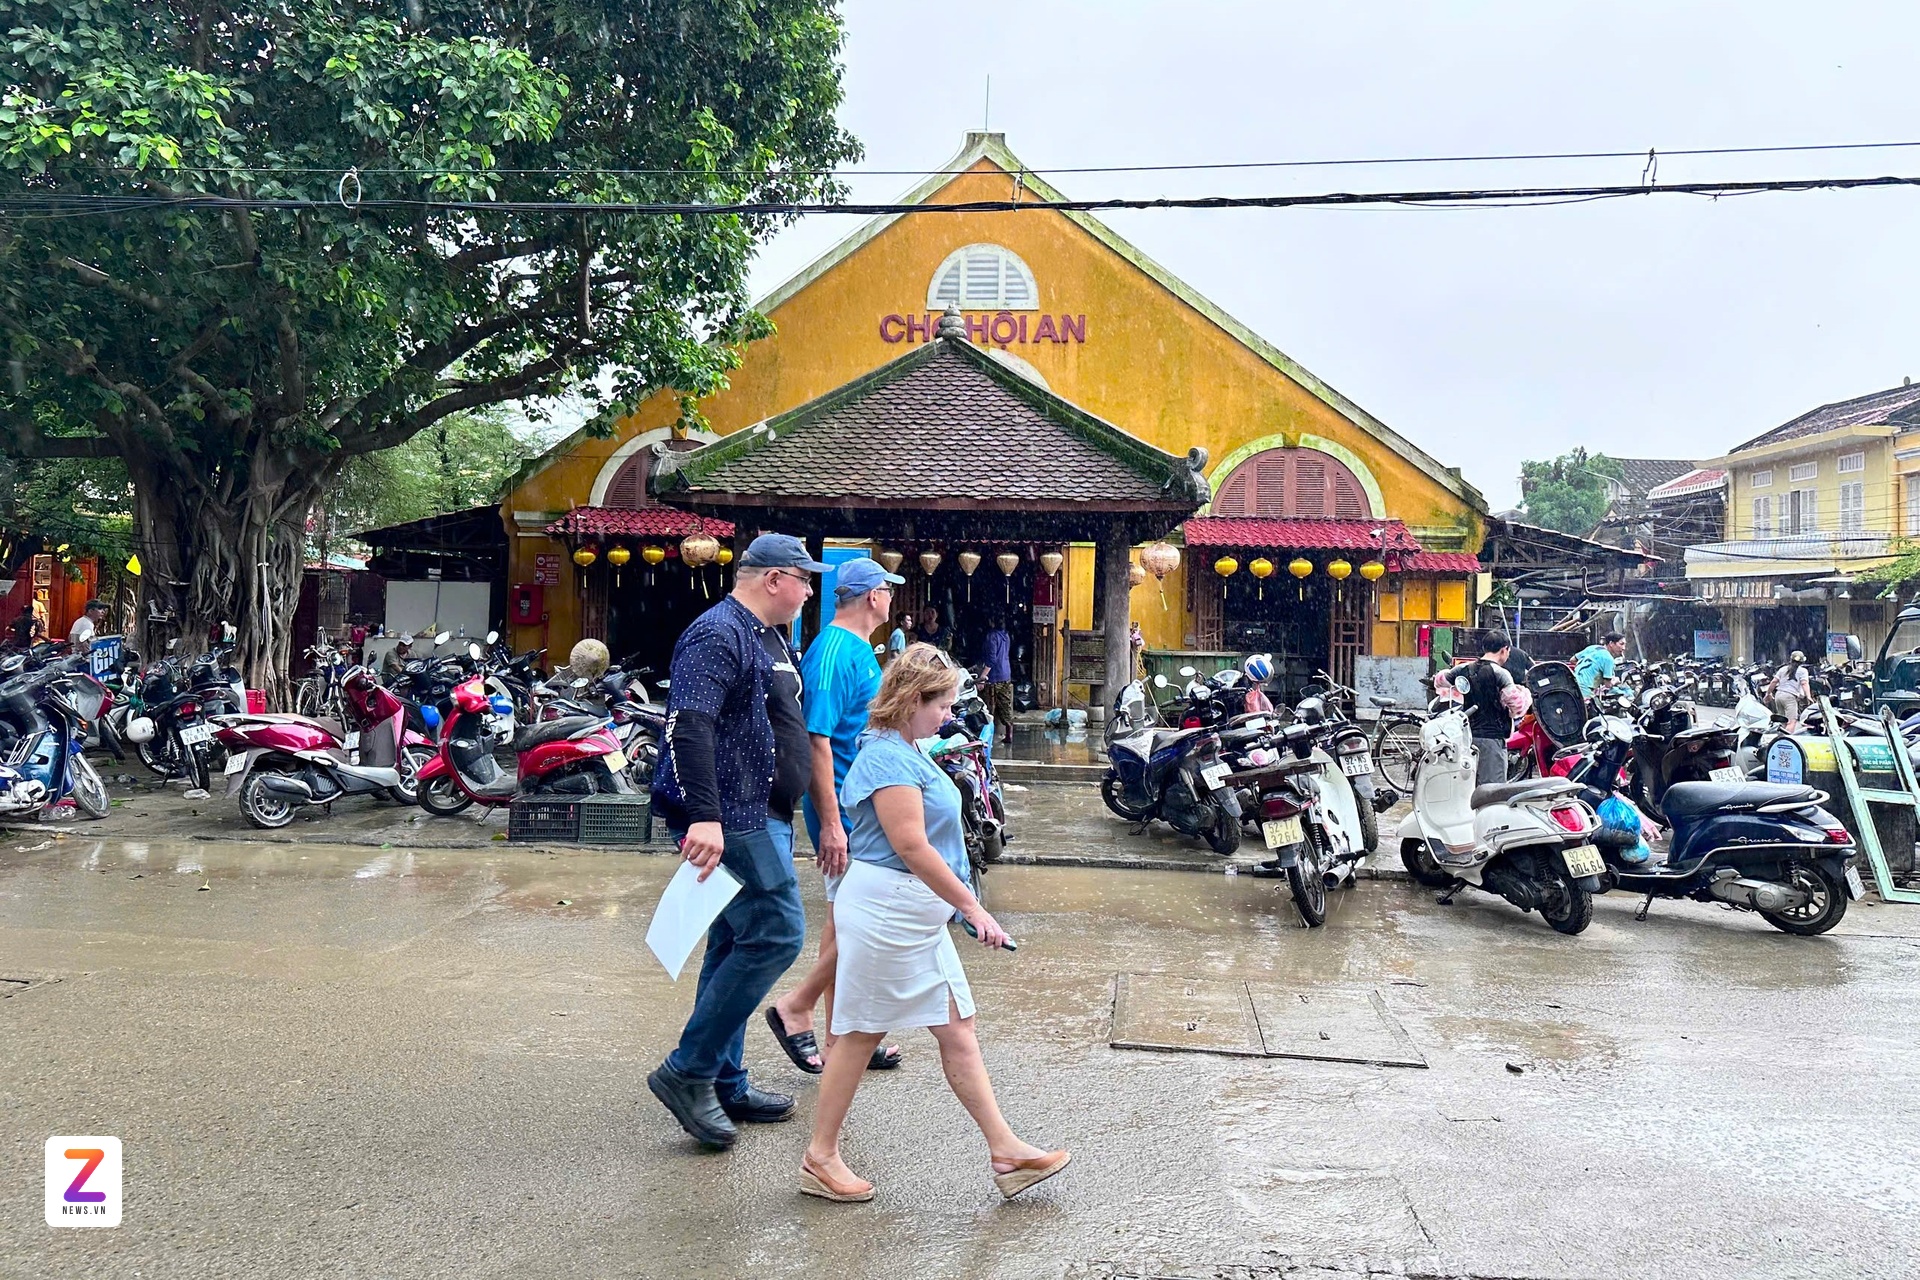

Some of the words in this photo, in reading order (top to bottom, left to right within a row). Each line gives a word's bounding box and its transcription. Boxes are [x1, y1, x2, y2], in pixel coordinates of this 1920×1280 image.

[966, 310, 1027, 350] HỘI
[1033, 314, 1086, 343] AN
[1347, 763, 1370, 775] 6126
[1714, 768, 1737, 780] 92-C1
[1270, 830, 1299, 846] 3264
[1568, 848, 1595, 863] 92-C1
